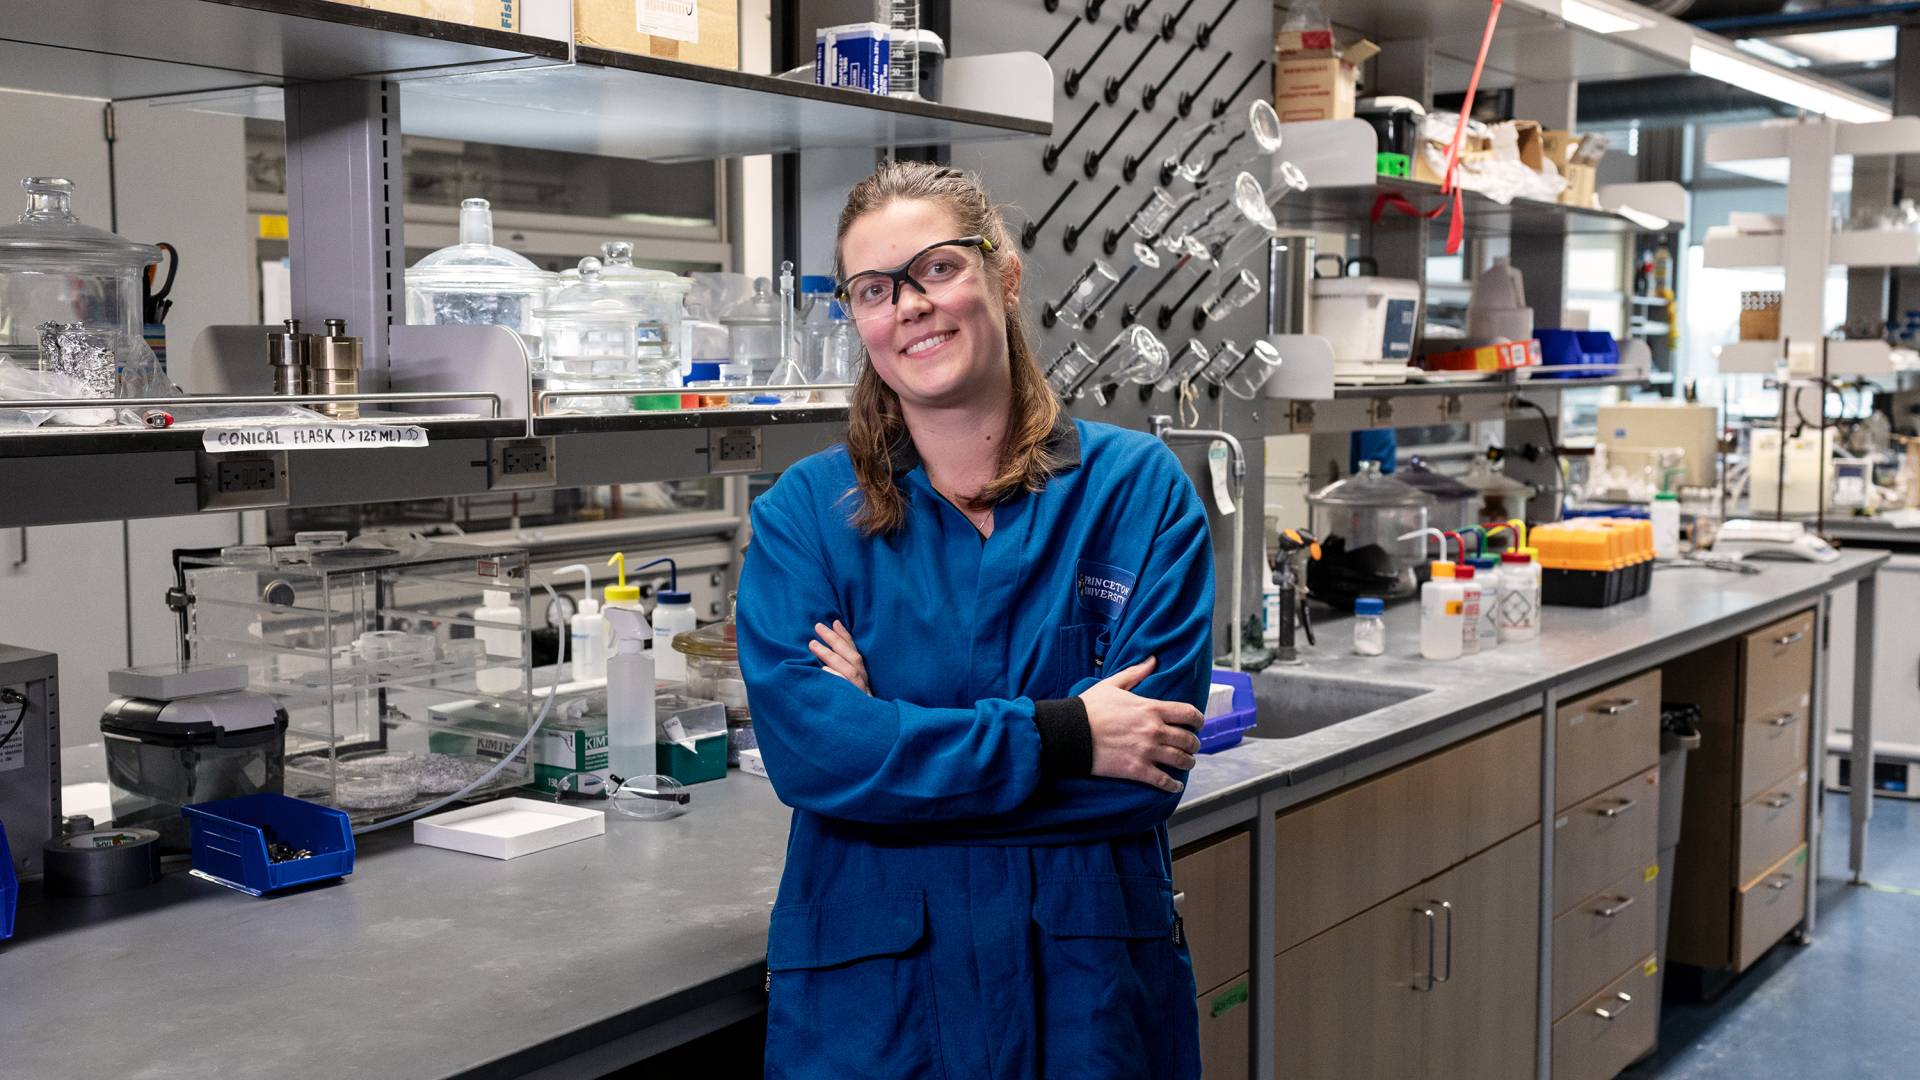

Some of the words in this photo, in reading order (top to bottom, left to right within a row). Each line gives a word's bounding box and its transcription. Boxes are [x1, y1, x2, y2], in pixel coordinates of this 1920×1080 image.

[501, 0, 512, 28] Fis
[218, 431, 284, 446] CONICAL
[294, 428, 336, 443] FLASK
[1084, 575, 1130, 596] PRINCETON
[585, 736, 608, 750] KIM
